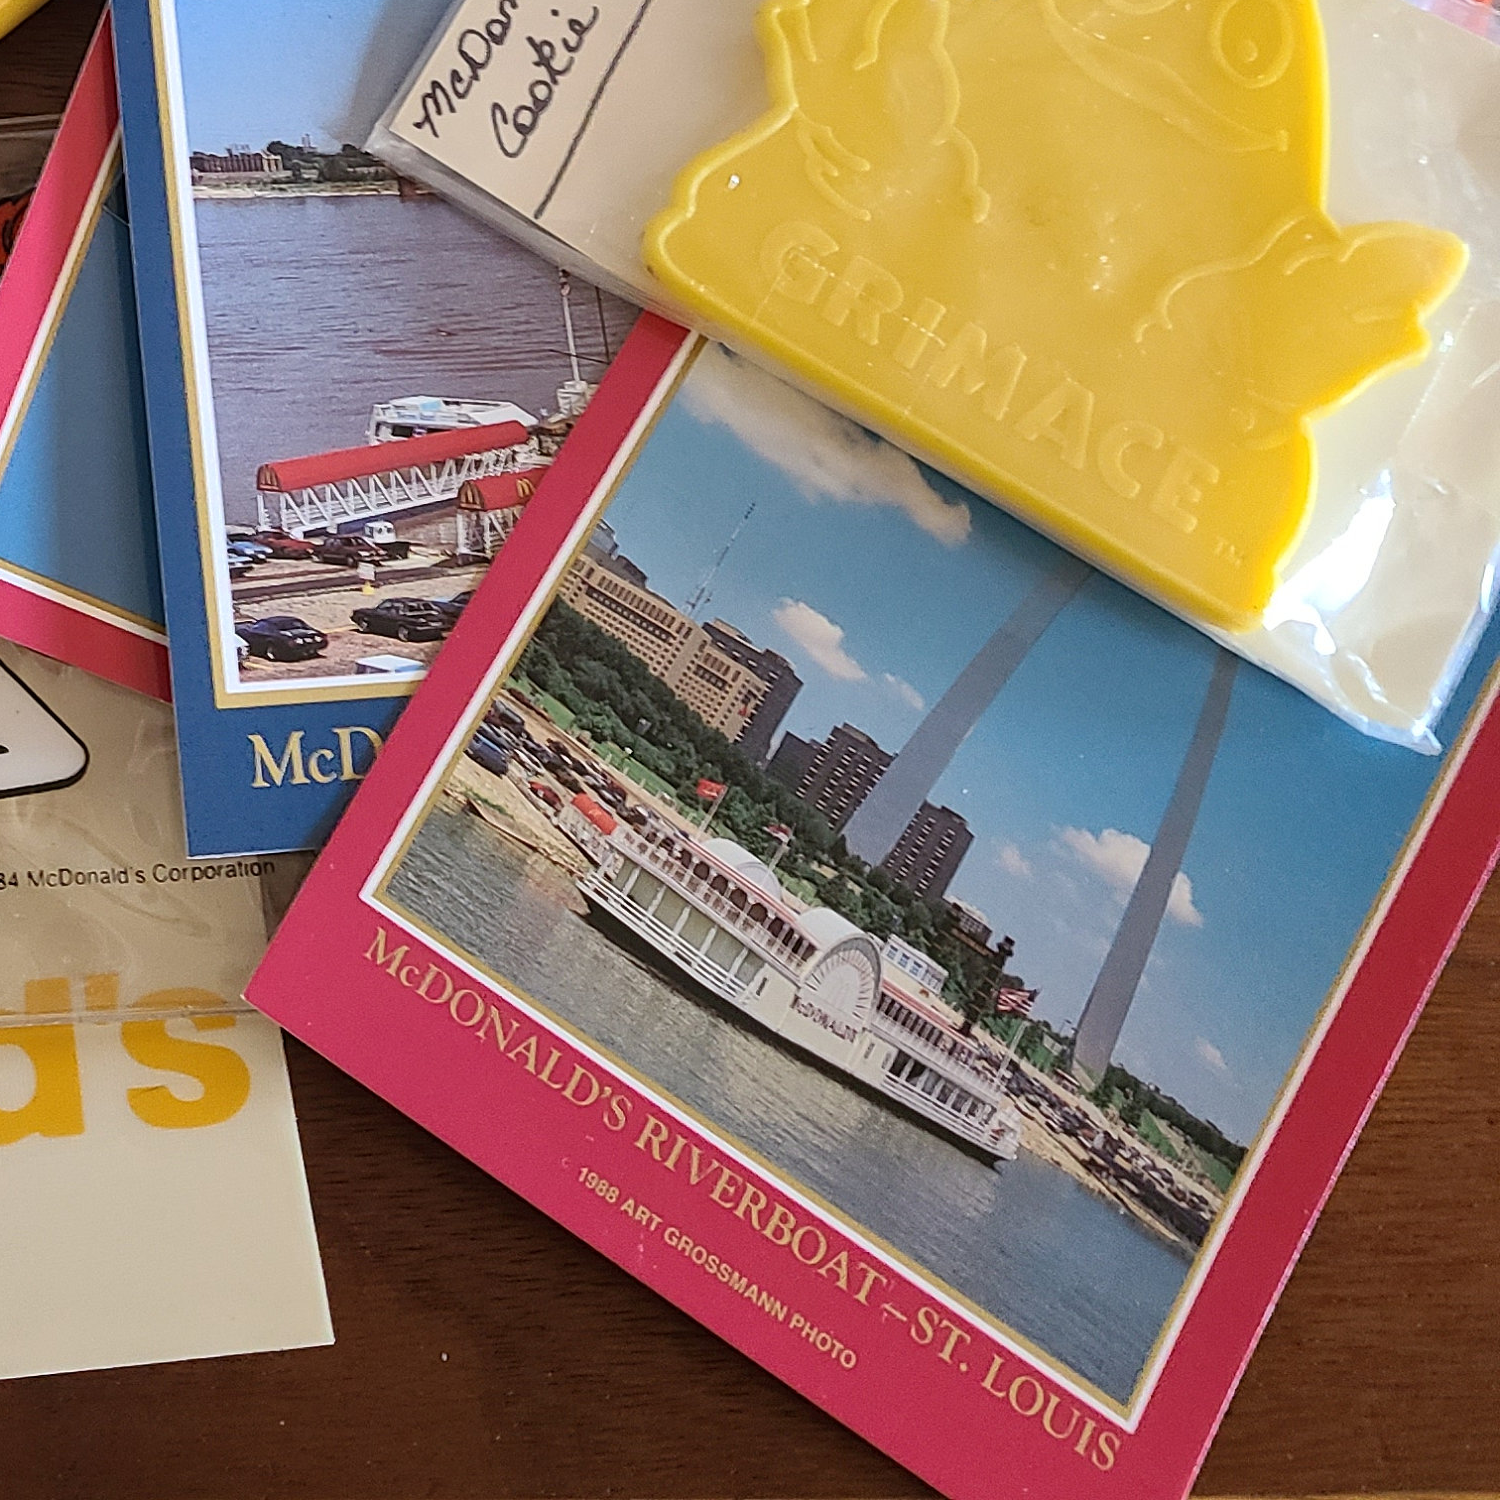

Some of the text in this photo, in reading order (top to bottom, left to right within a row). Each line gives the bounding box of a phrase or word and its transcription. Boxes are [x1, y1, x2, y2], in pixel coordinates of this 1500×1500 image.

[490, 4, 600, 160] Cookie
[760, 219, 1221, 536] GRIMACE
[27, 866, 147, 890] McDonald's
[152, 858, 276, 884] Corporation
[362, 927, 634, 1132] McDONALD'S
[981, 1353, 1123, 1473] LOUIS
[578, 1165, 858, 1371] 1988 ART GROSSMANN PHOTO
